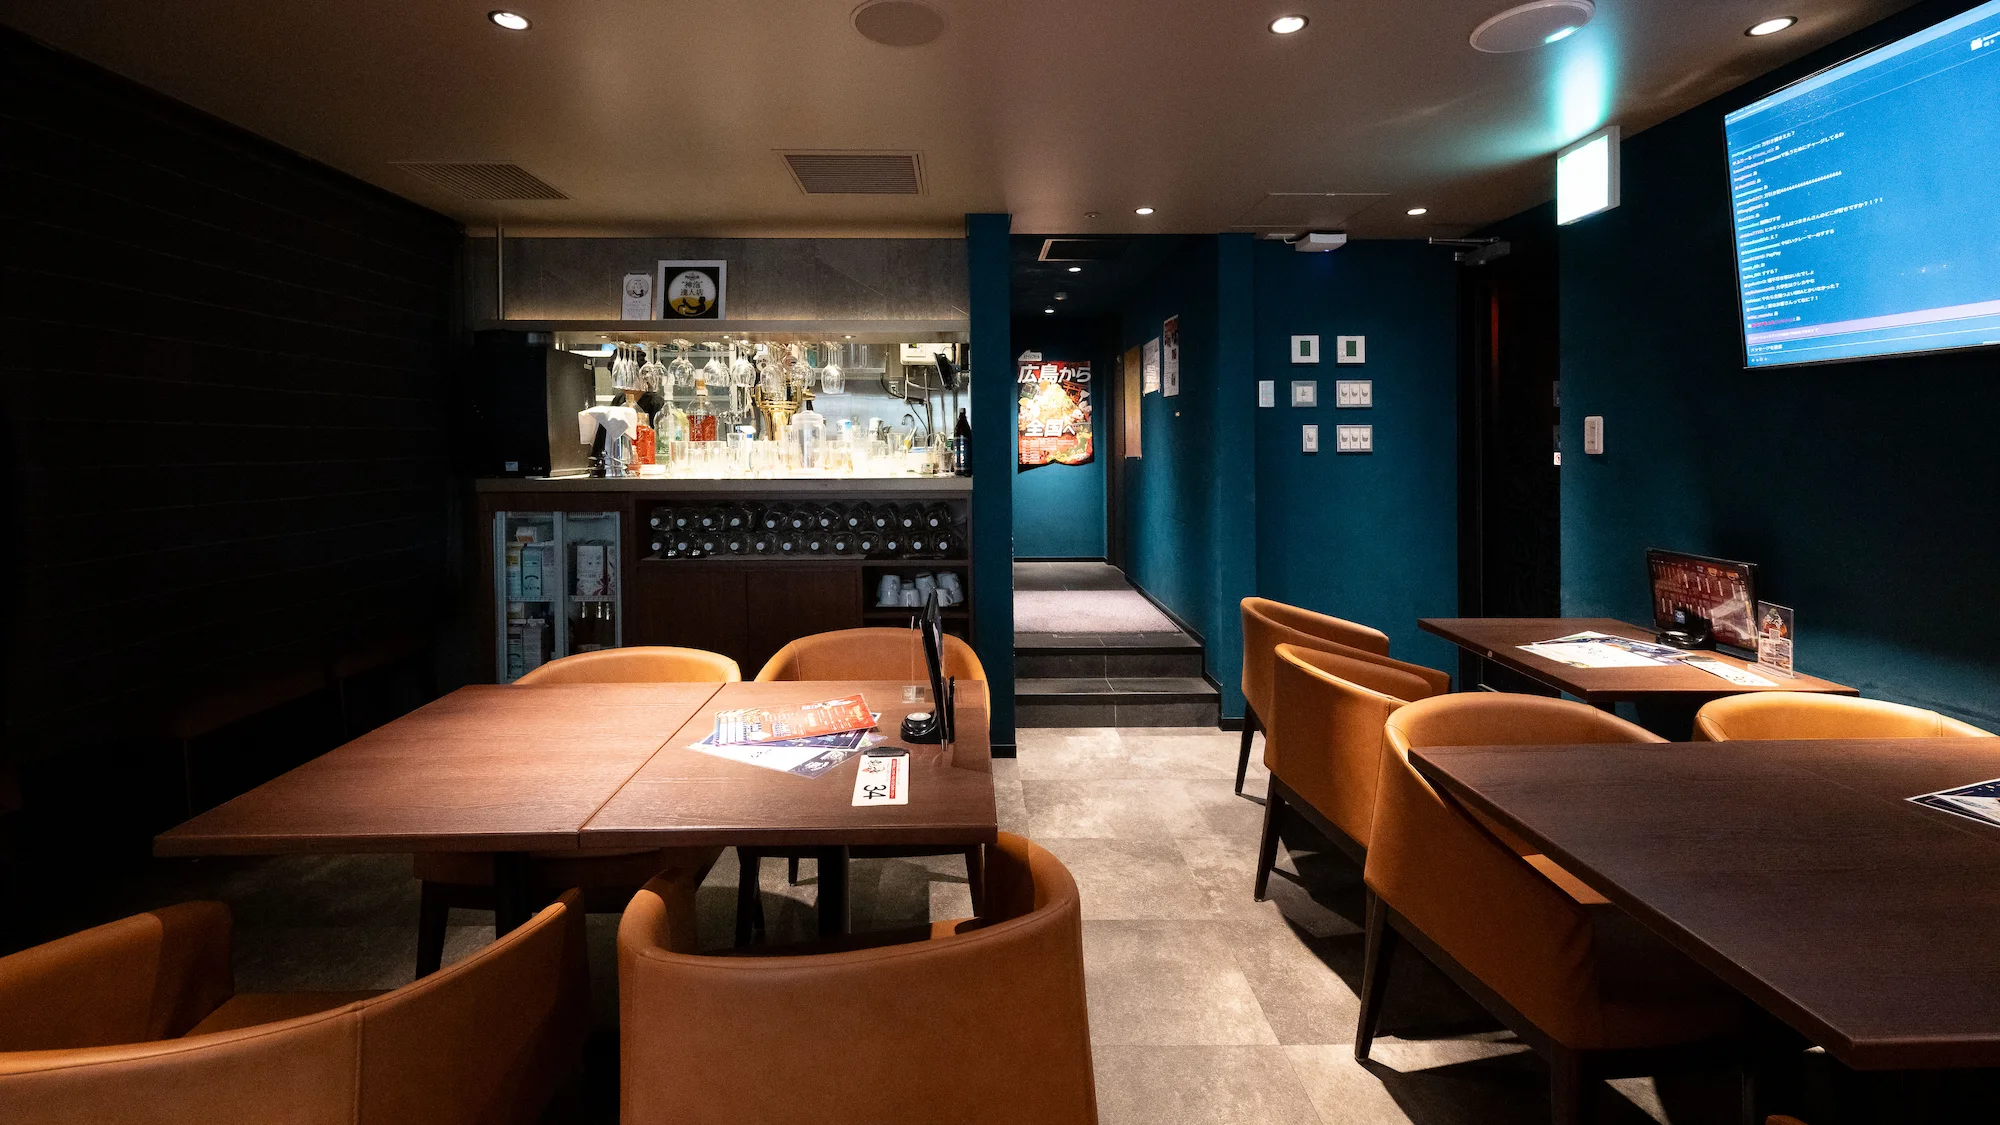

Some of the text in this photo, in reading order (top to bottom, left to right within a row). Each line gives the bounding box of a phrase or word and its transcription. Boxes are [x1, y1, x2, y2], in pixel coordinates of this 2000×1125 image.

[1018, 364, 1092, 384] 広島から
[1025, 418, 1076, 437] 全国へ
[863, 784, 887, 800] 34
